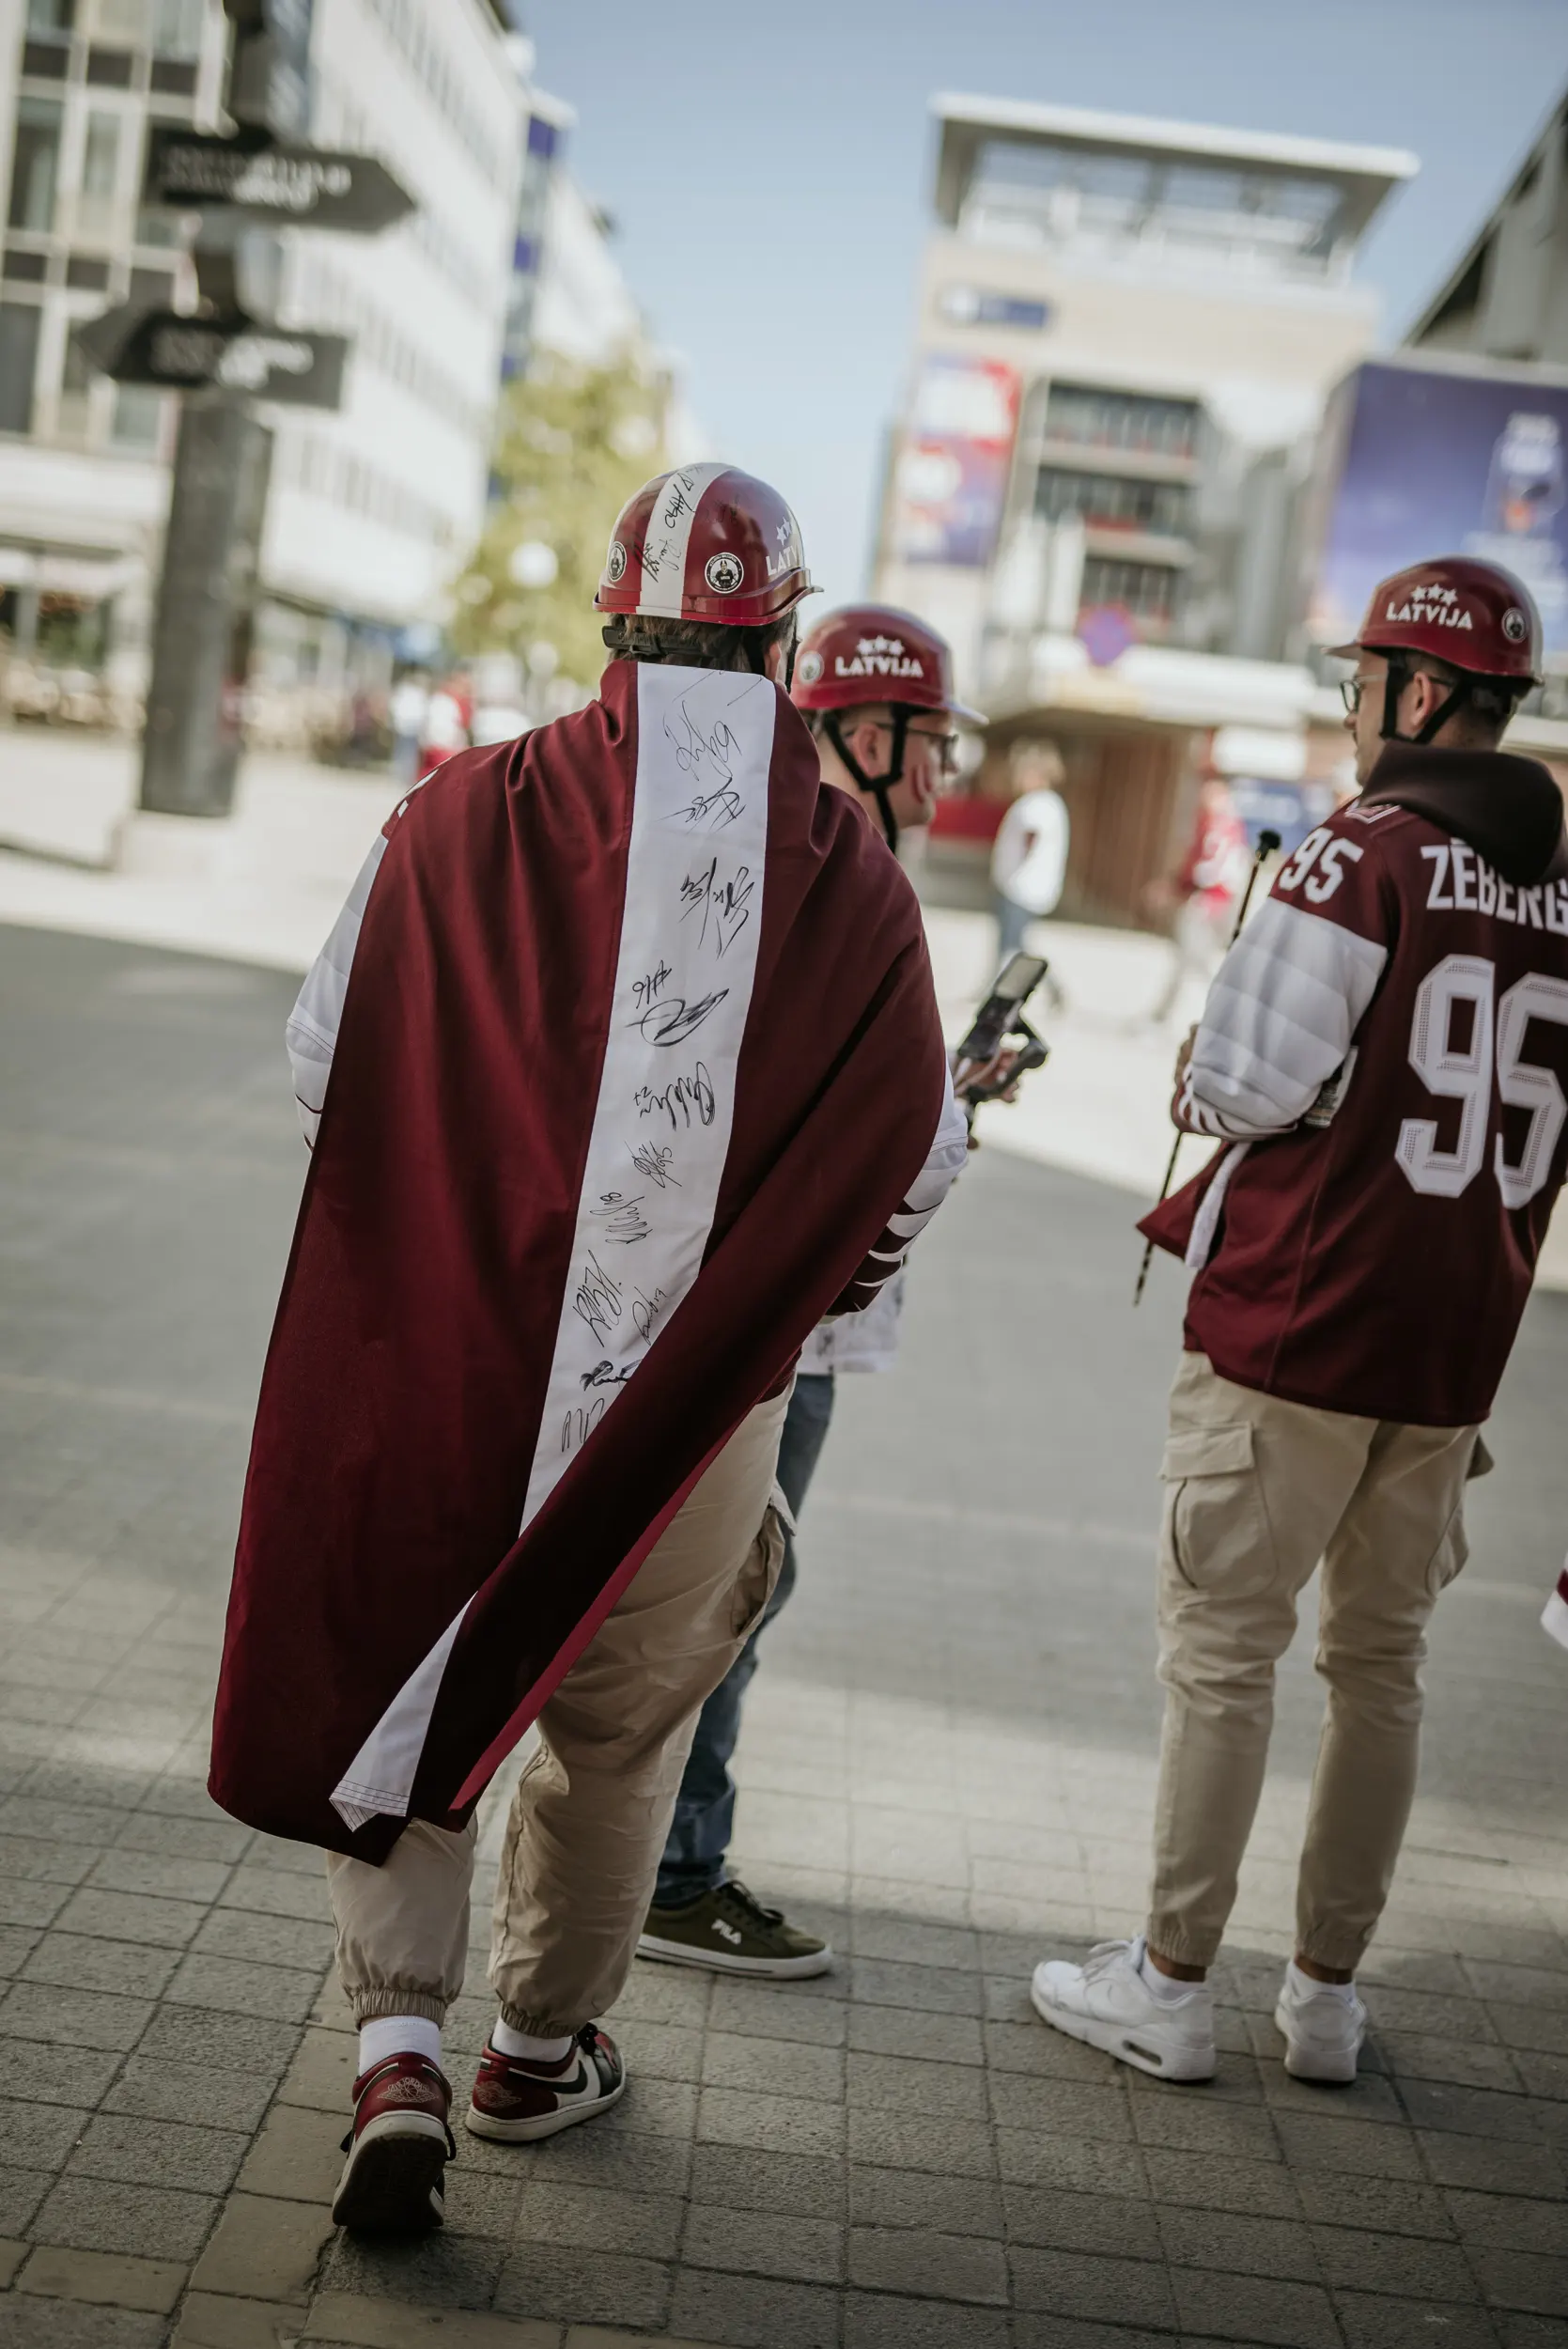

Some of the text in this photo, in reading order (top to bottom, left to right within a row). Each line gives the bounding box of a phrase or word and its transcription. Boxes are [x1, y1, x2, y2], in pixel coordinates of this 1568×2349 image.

[1386, 601, 1473, 630] LATVIJA
[834, 655, 924, 677] LATVIJA
[1279, 827, 1365, 904] 95
[1394, 953, 1568, 1210] 95
[711, 1918, 741, 1944] FILA
